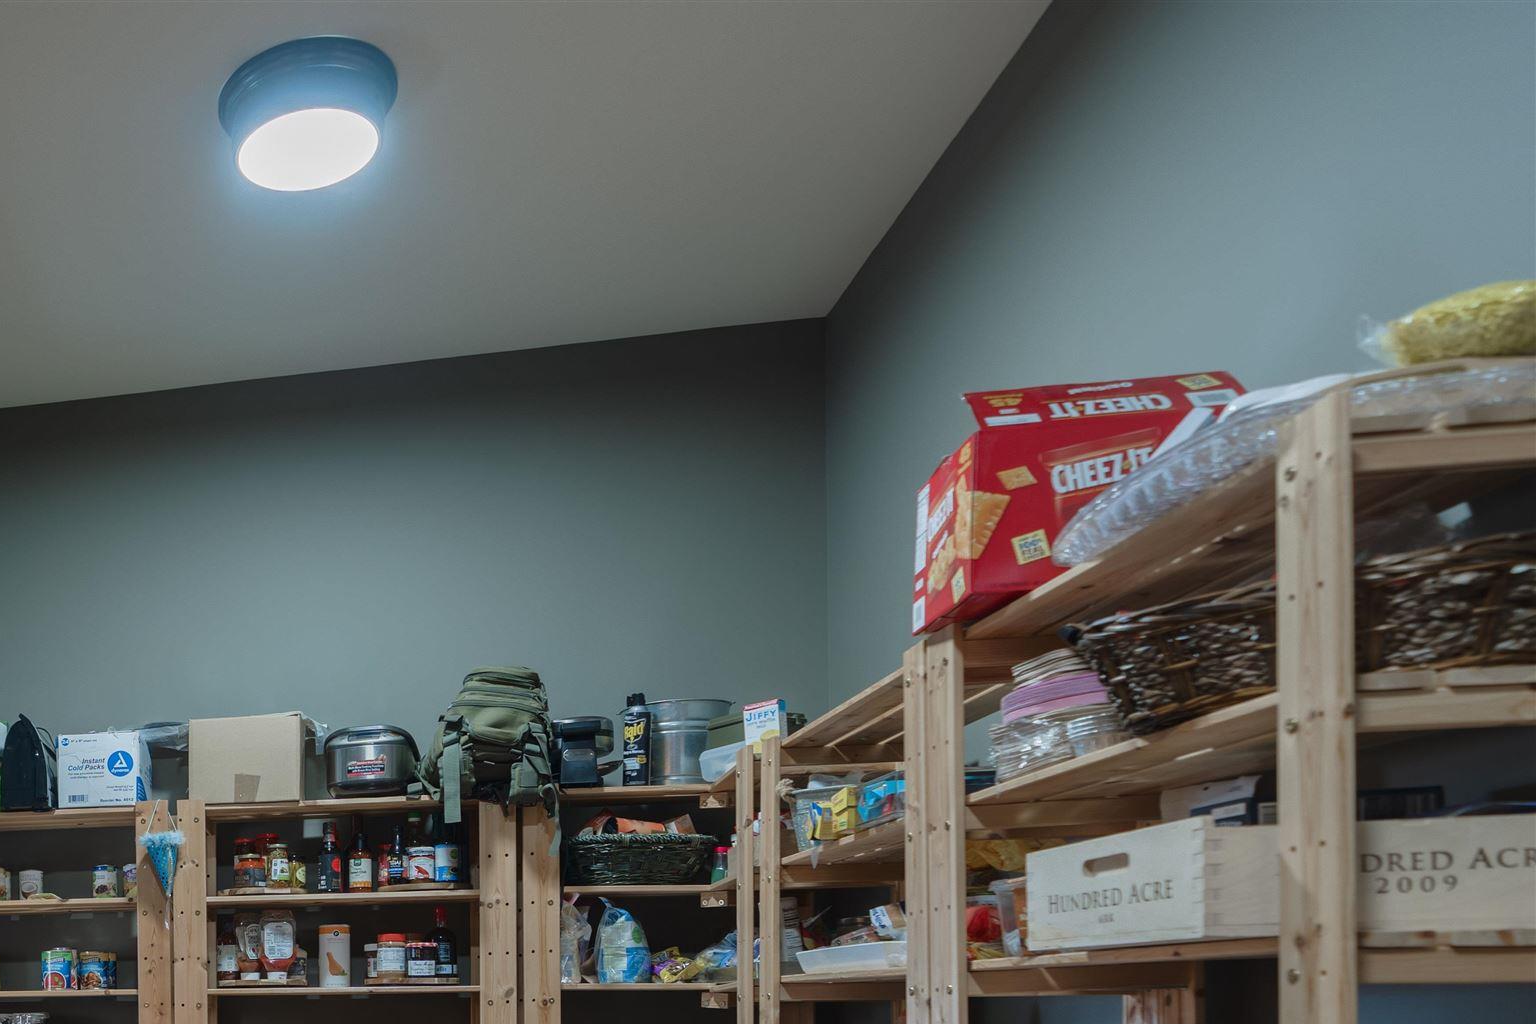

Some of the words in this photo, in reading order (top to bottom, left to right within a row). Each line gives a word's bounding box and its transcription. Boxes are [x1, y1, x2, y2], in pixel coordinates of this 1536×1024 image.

[746, 709, 777, 722] JIFFY
[1360, 850, 1455, 874] DRED
[1375, 874, 1458, 895] 2009
[1047, 887, 1123, 914] HUNDRED
[1127, 879, 1174, 905] ACRE
